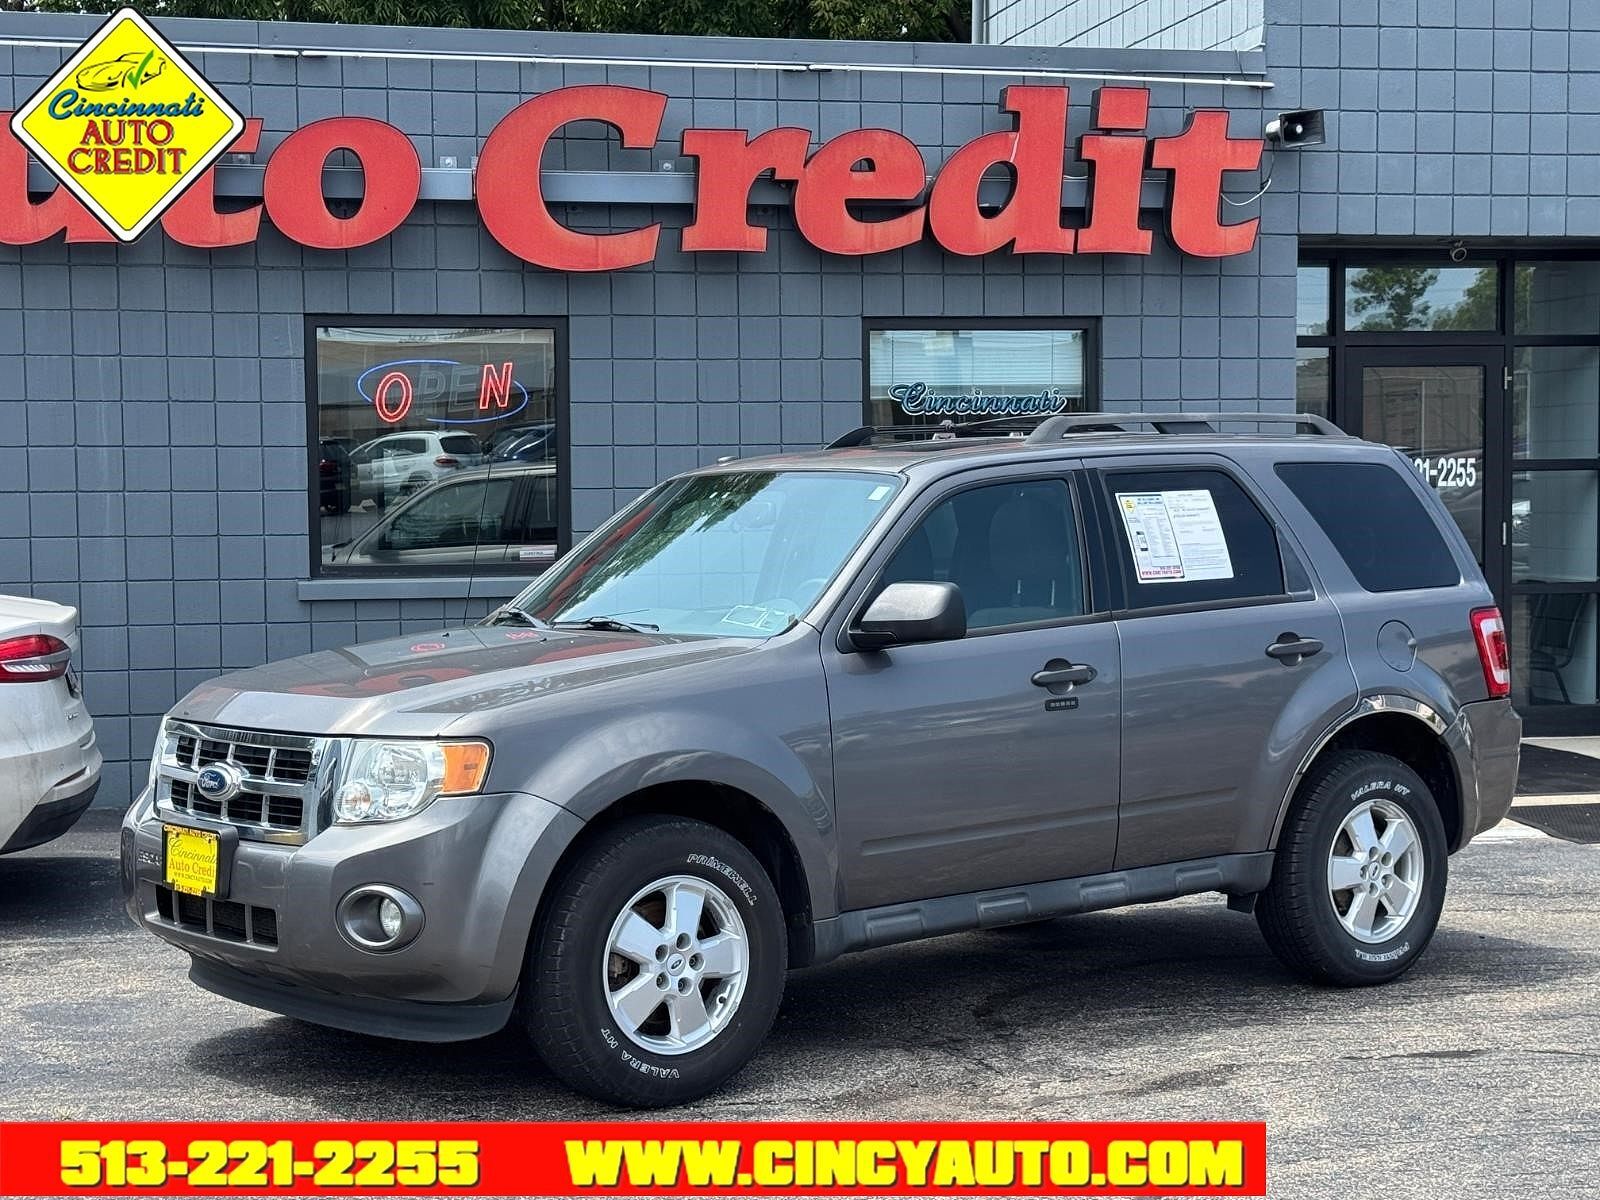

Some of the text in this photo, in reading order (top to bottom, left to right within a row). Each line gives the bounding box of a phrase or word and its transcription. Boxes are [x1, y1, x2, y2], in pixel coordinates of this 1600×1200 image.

[475, 85, 1265, 271] Credit
[376, 362, 513, 422] OPEN
[888, 382, 1067, 416] Cincinnati
[191, 861, 215, 878] Credi
[620, 1048, 680, 1079] VALERA
